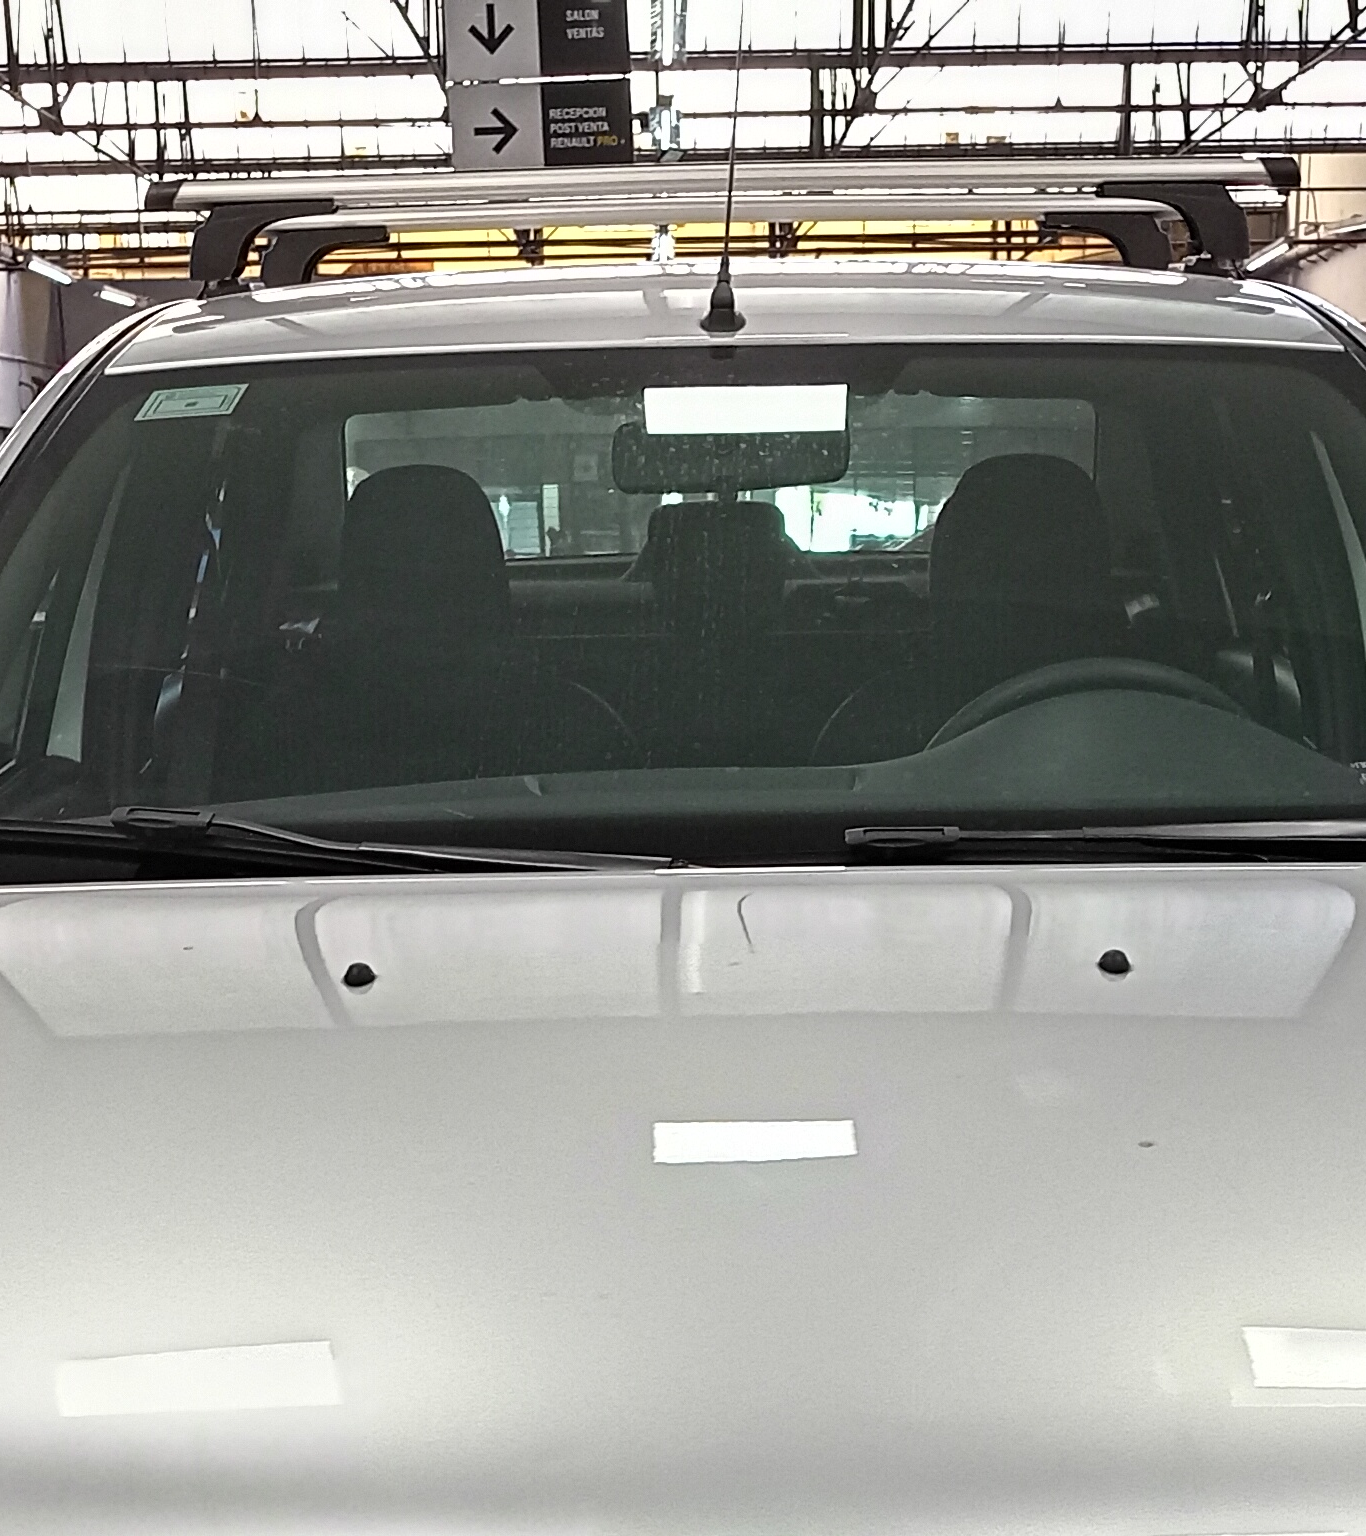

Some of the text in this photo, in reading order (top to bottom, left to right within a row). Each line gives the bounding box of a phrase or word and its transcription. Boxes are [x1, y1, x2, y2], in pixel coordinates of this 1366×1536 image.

[566, 9, 599, 21] SALON
[566, 27, 605, 39] VENTAS
[549, 107, 607, 119] RECEPCION
[551, 136, 595, 148] RENAULT
